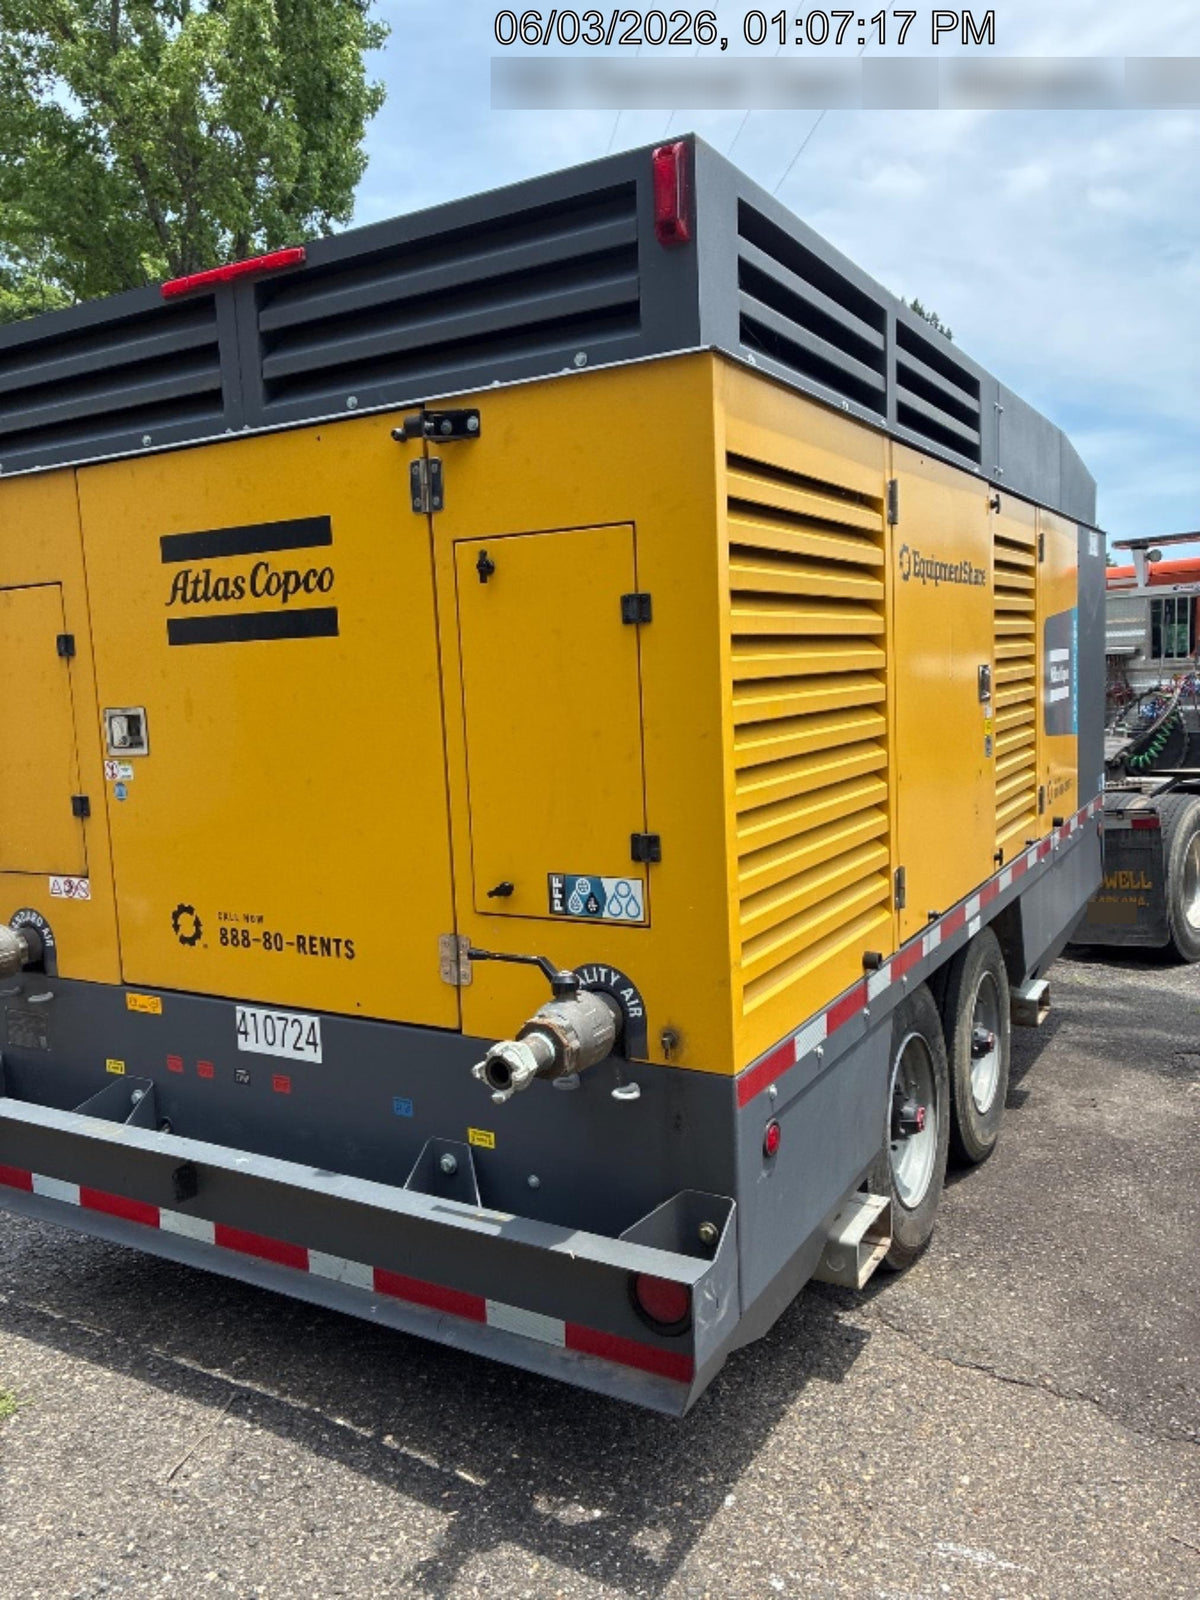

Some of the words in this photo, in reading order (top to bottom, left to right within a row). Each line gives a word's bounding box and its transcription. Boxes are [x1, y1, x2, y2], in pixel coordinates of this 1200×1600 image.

[165, 569, 246, 607] Atlas
[250, 561, 335, 604] Copco
[553, 876, 563, 911] PFF
[1102, 870, 1153, 889] WELL
[218, 912, 239, 922] CALL
[243, 913, 264, 924] NOW
[219, 927, 356, 961] 888-80-RENTS
[576, 966, 621, 989] ALITY
[621, 987, 643, 1018] AIR
[237, 1011, 319, 1053] 410724
